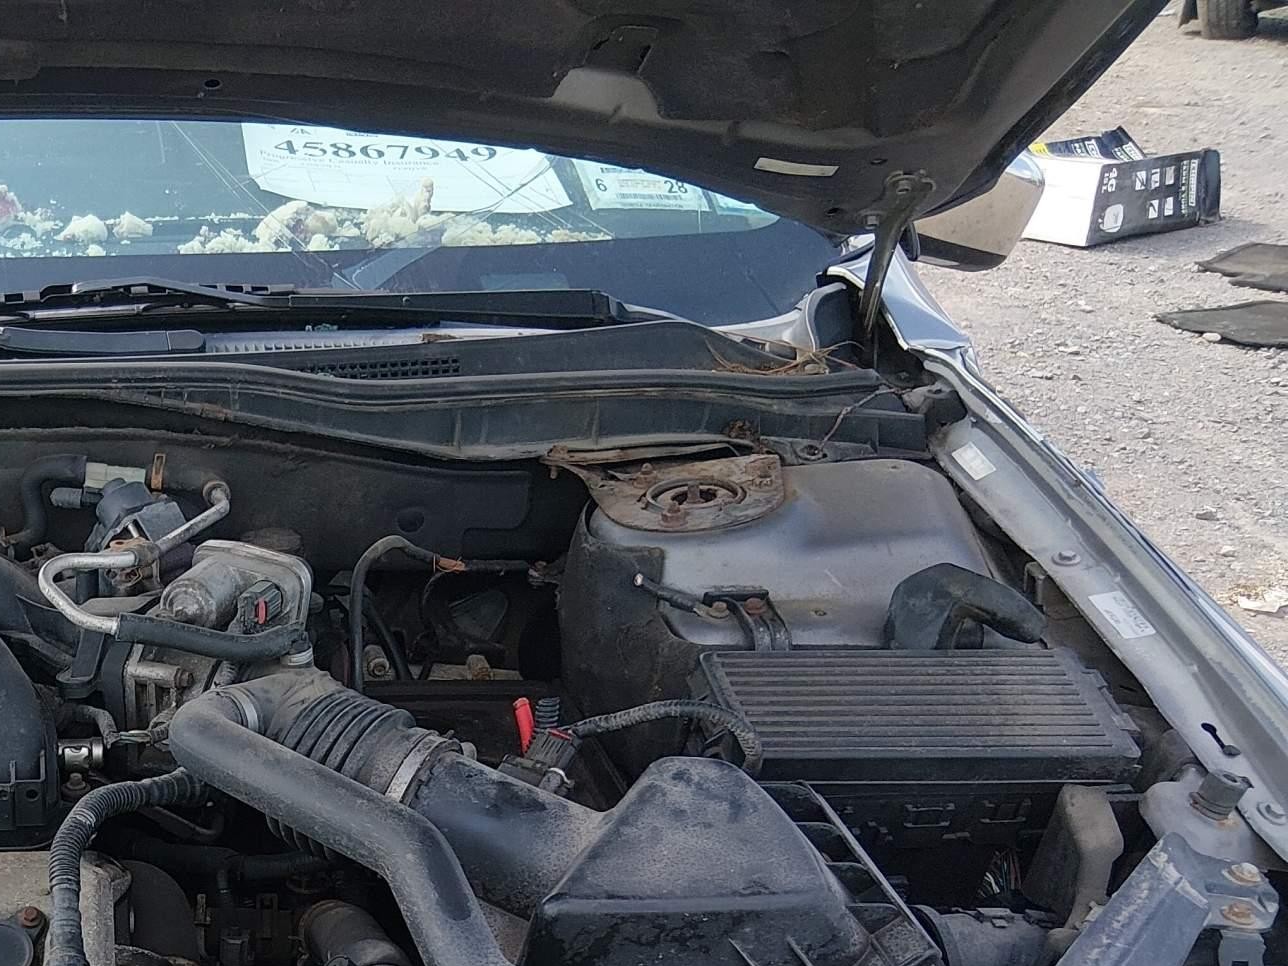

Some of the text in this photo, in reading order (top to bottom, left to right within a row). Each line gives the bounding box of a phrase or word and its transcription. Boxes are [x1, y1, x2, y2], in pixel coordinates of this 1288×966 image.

[274, 139, 497, 162] 45867949
[595, 178, 608, 193] 6
[663, 180, 688, 193] 28
